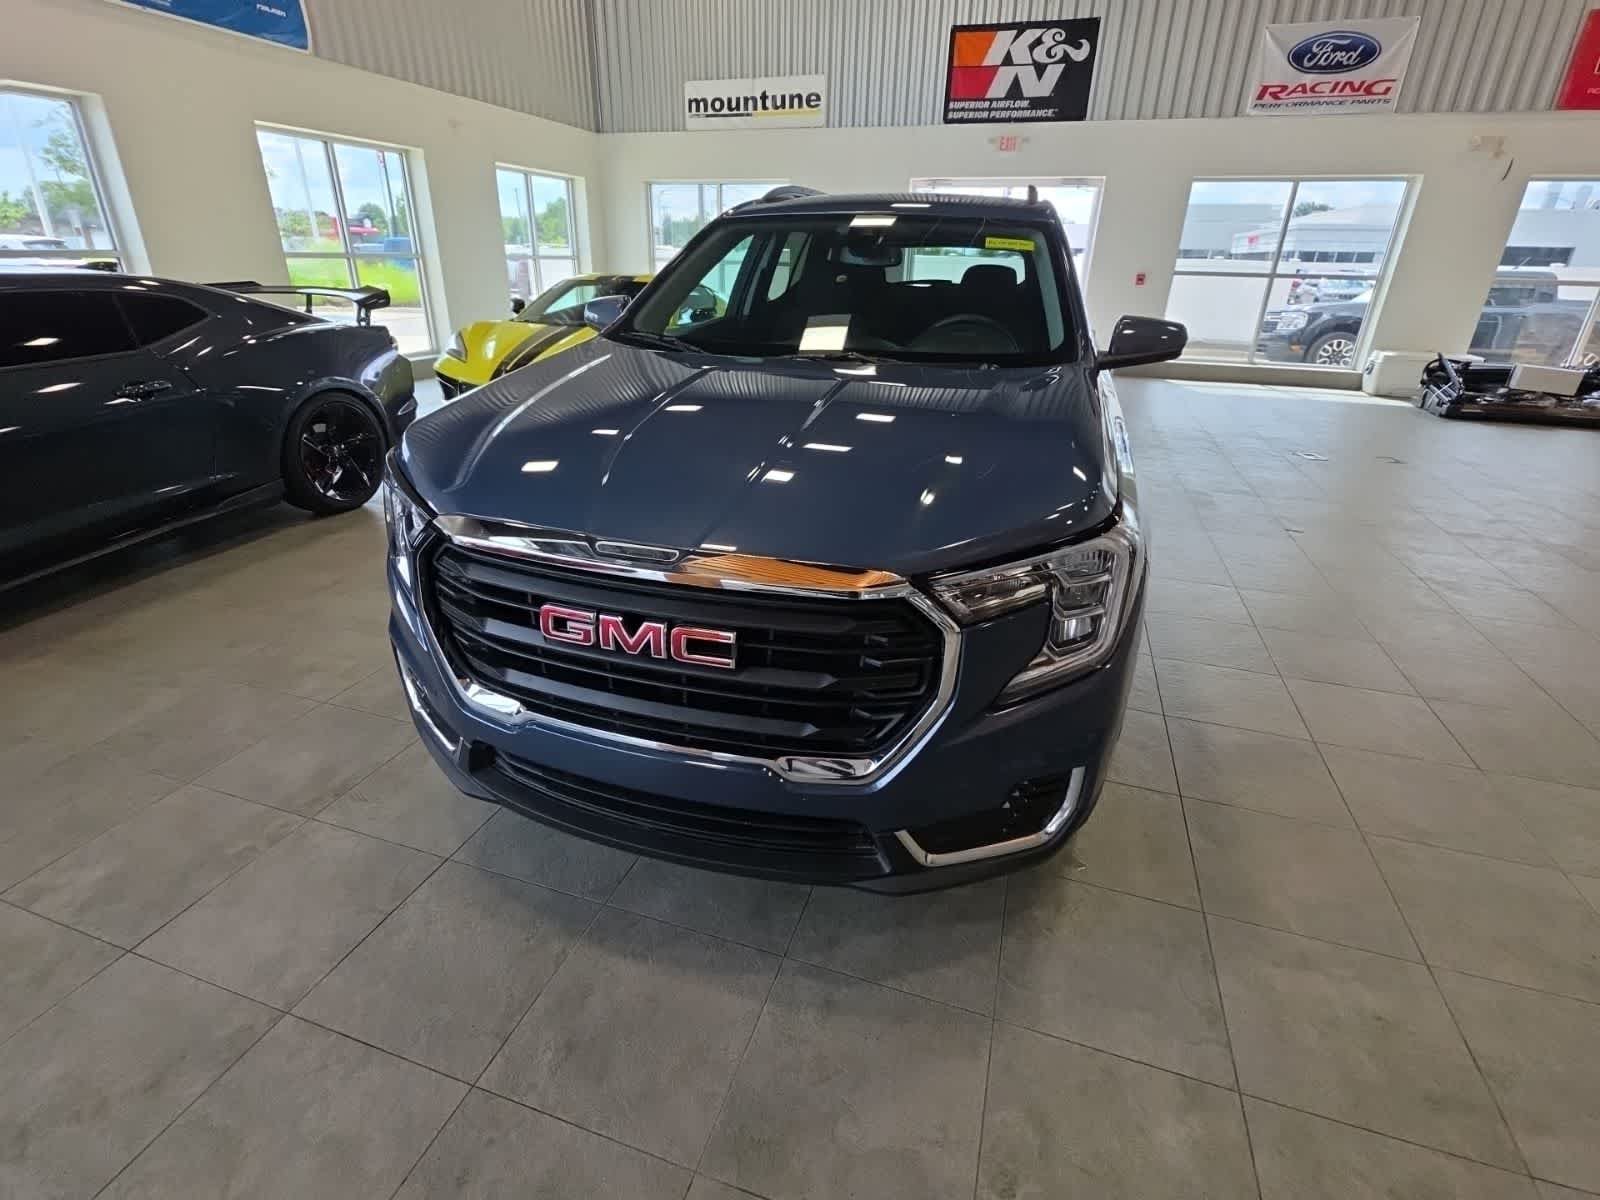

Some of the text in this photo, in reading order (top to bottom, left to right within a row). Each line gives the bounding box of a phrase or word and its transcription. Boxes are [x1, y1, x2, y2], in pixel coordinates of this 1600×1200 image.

[1303, 38, 1366, 67] Ford
[1256, 79, 1397, 101] RACING
[687, 90, 822, 113] mountune
[949, 101, 990, 109] SUPERIOR
[1253, 99, 1347, 109] PERFORMANCE
[947, 110, 989, 119] SUPERIOR
[999, 136, 1016, 152] EXIT
[539, 604, 737, 669] GMC
